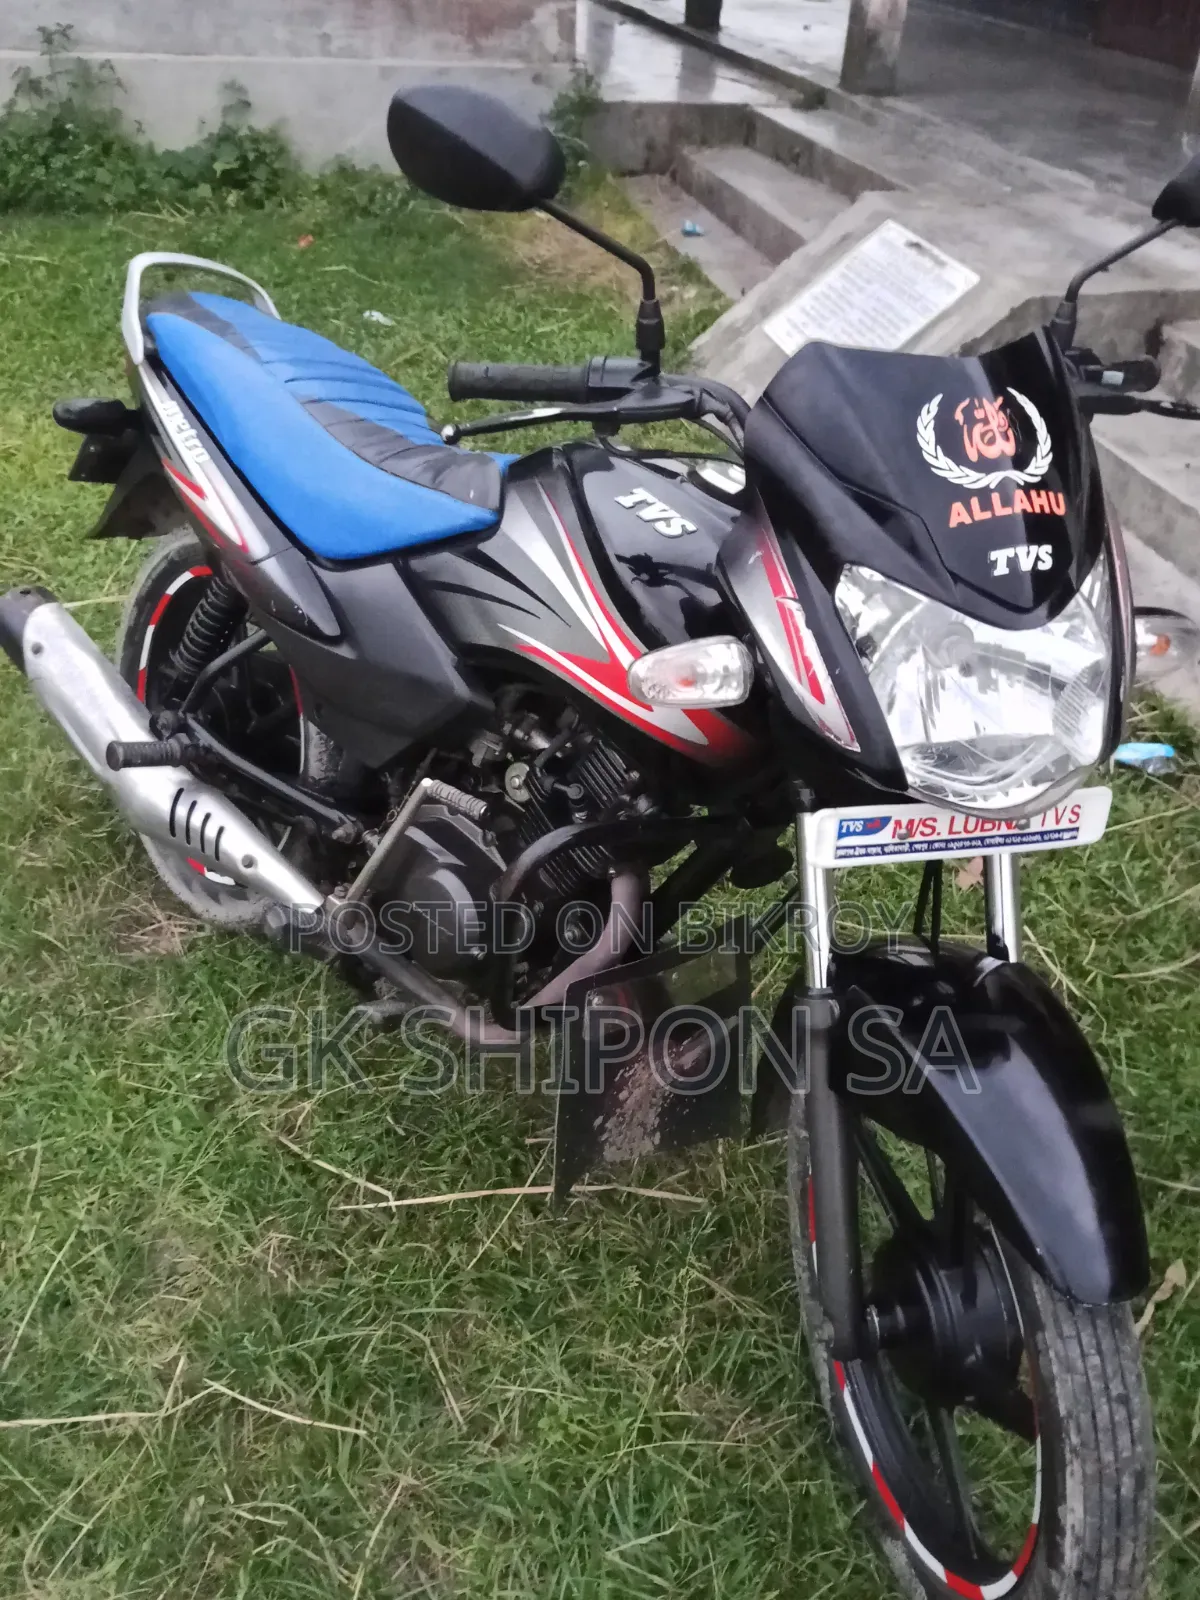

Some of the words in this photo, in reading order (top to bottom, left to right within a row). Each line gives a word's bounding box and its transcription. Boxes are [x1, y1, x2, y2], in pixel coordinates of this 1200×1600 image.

[613, 487, 699, 538] TVS
[949, 489, 1066, 528] ALLAHU
[988, 544, 1053, 577] TVS
[841, 820, 864, 833] TVS
